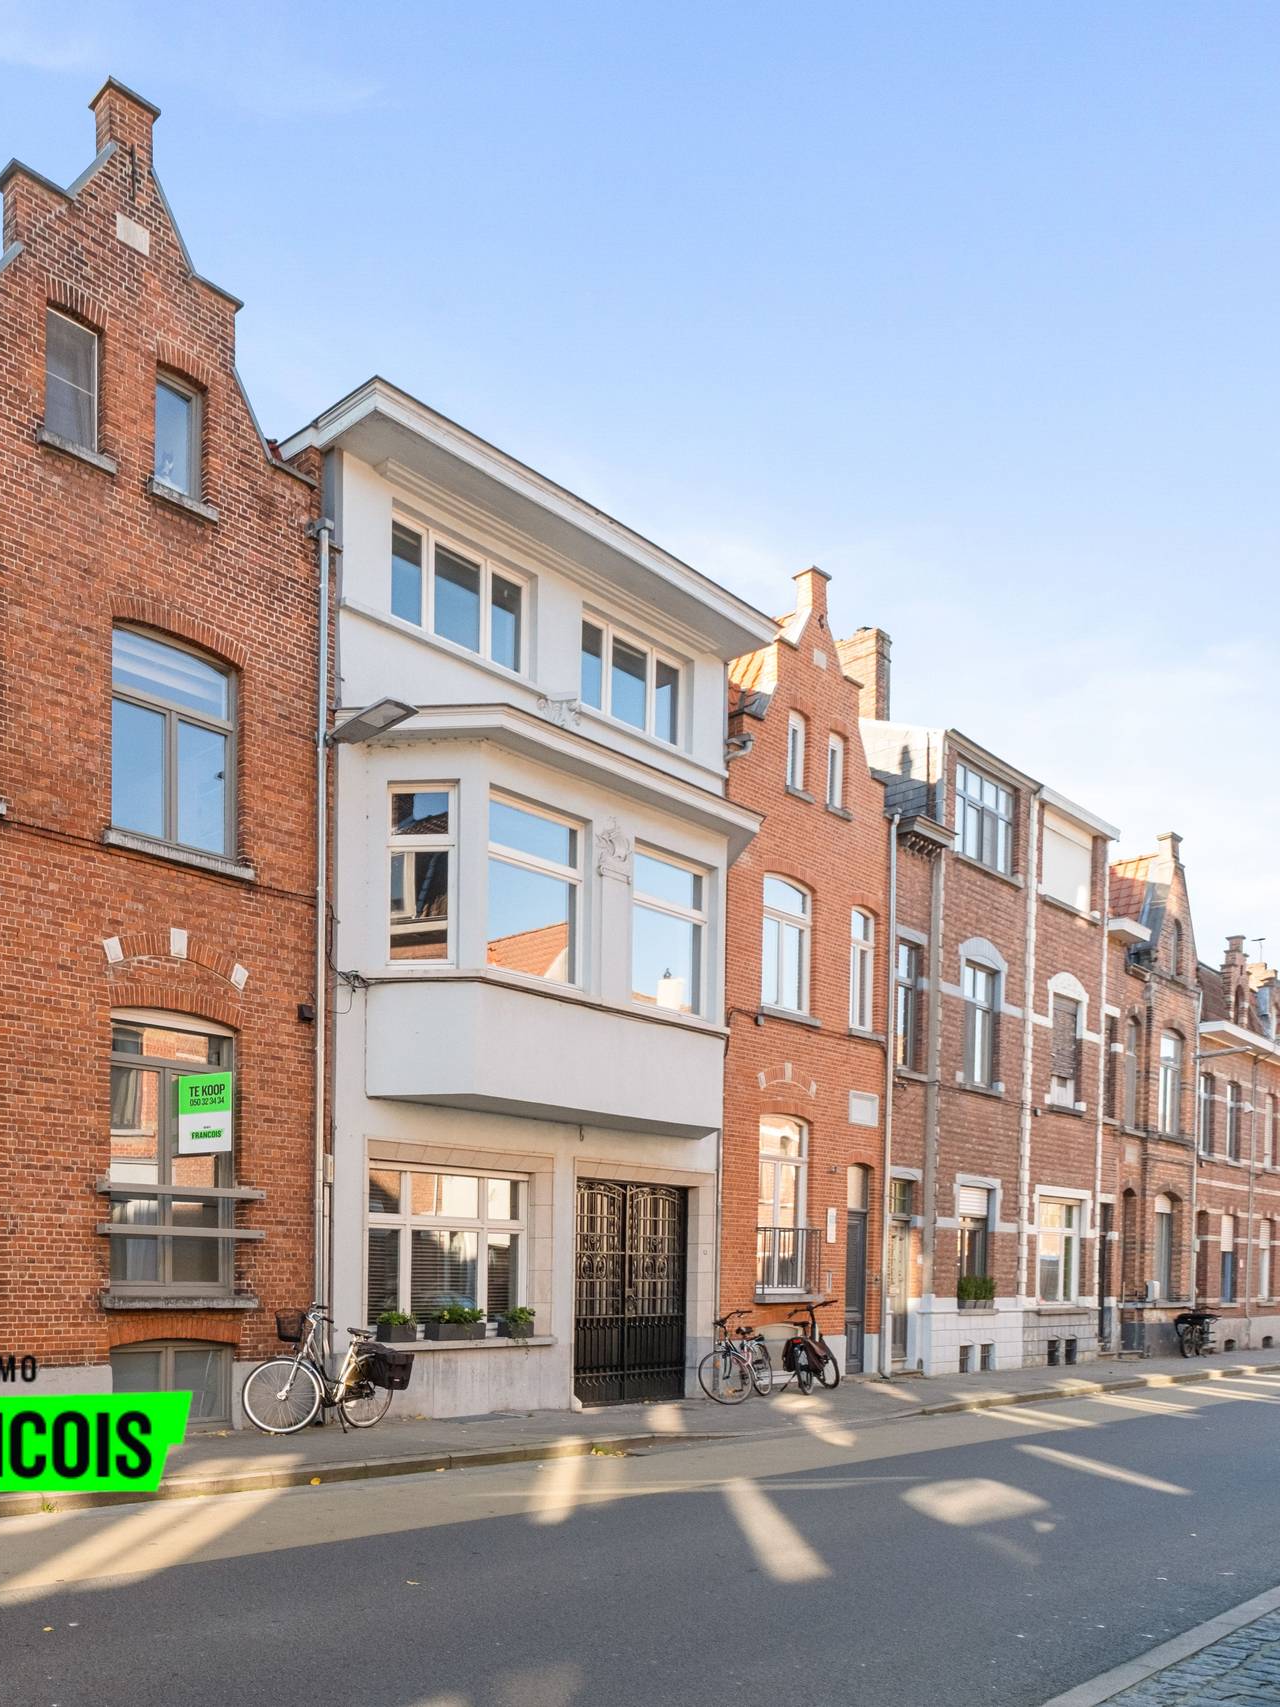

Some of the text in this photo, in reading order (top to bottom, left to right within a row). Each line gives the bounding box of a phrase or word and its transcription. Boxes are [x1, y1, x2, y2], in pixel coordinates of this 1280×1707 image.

[189, 1084, 225, 1097] TE KOOP
[191, 1130, 222, 1140] FRANCOIS
